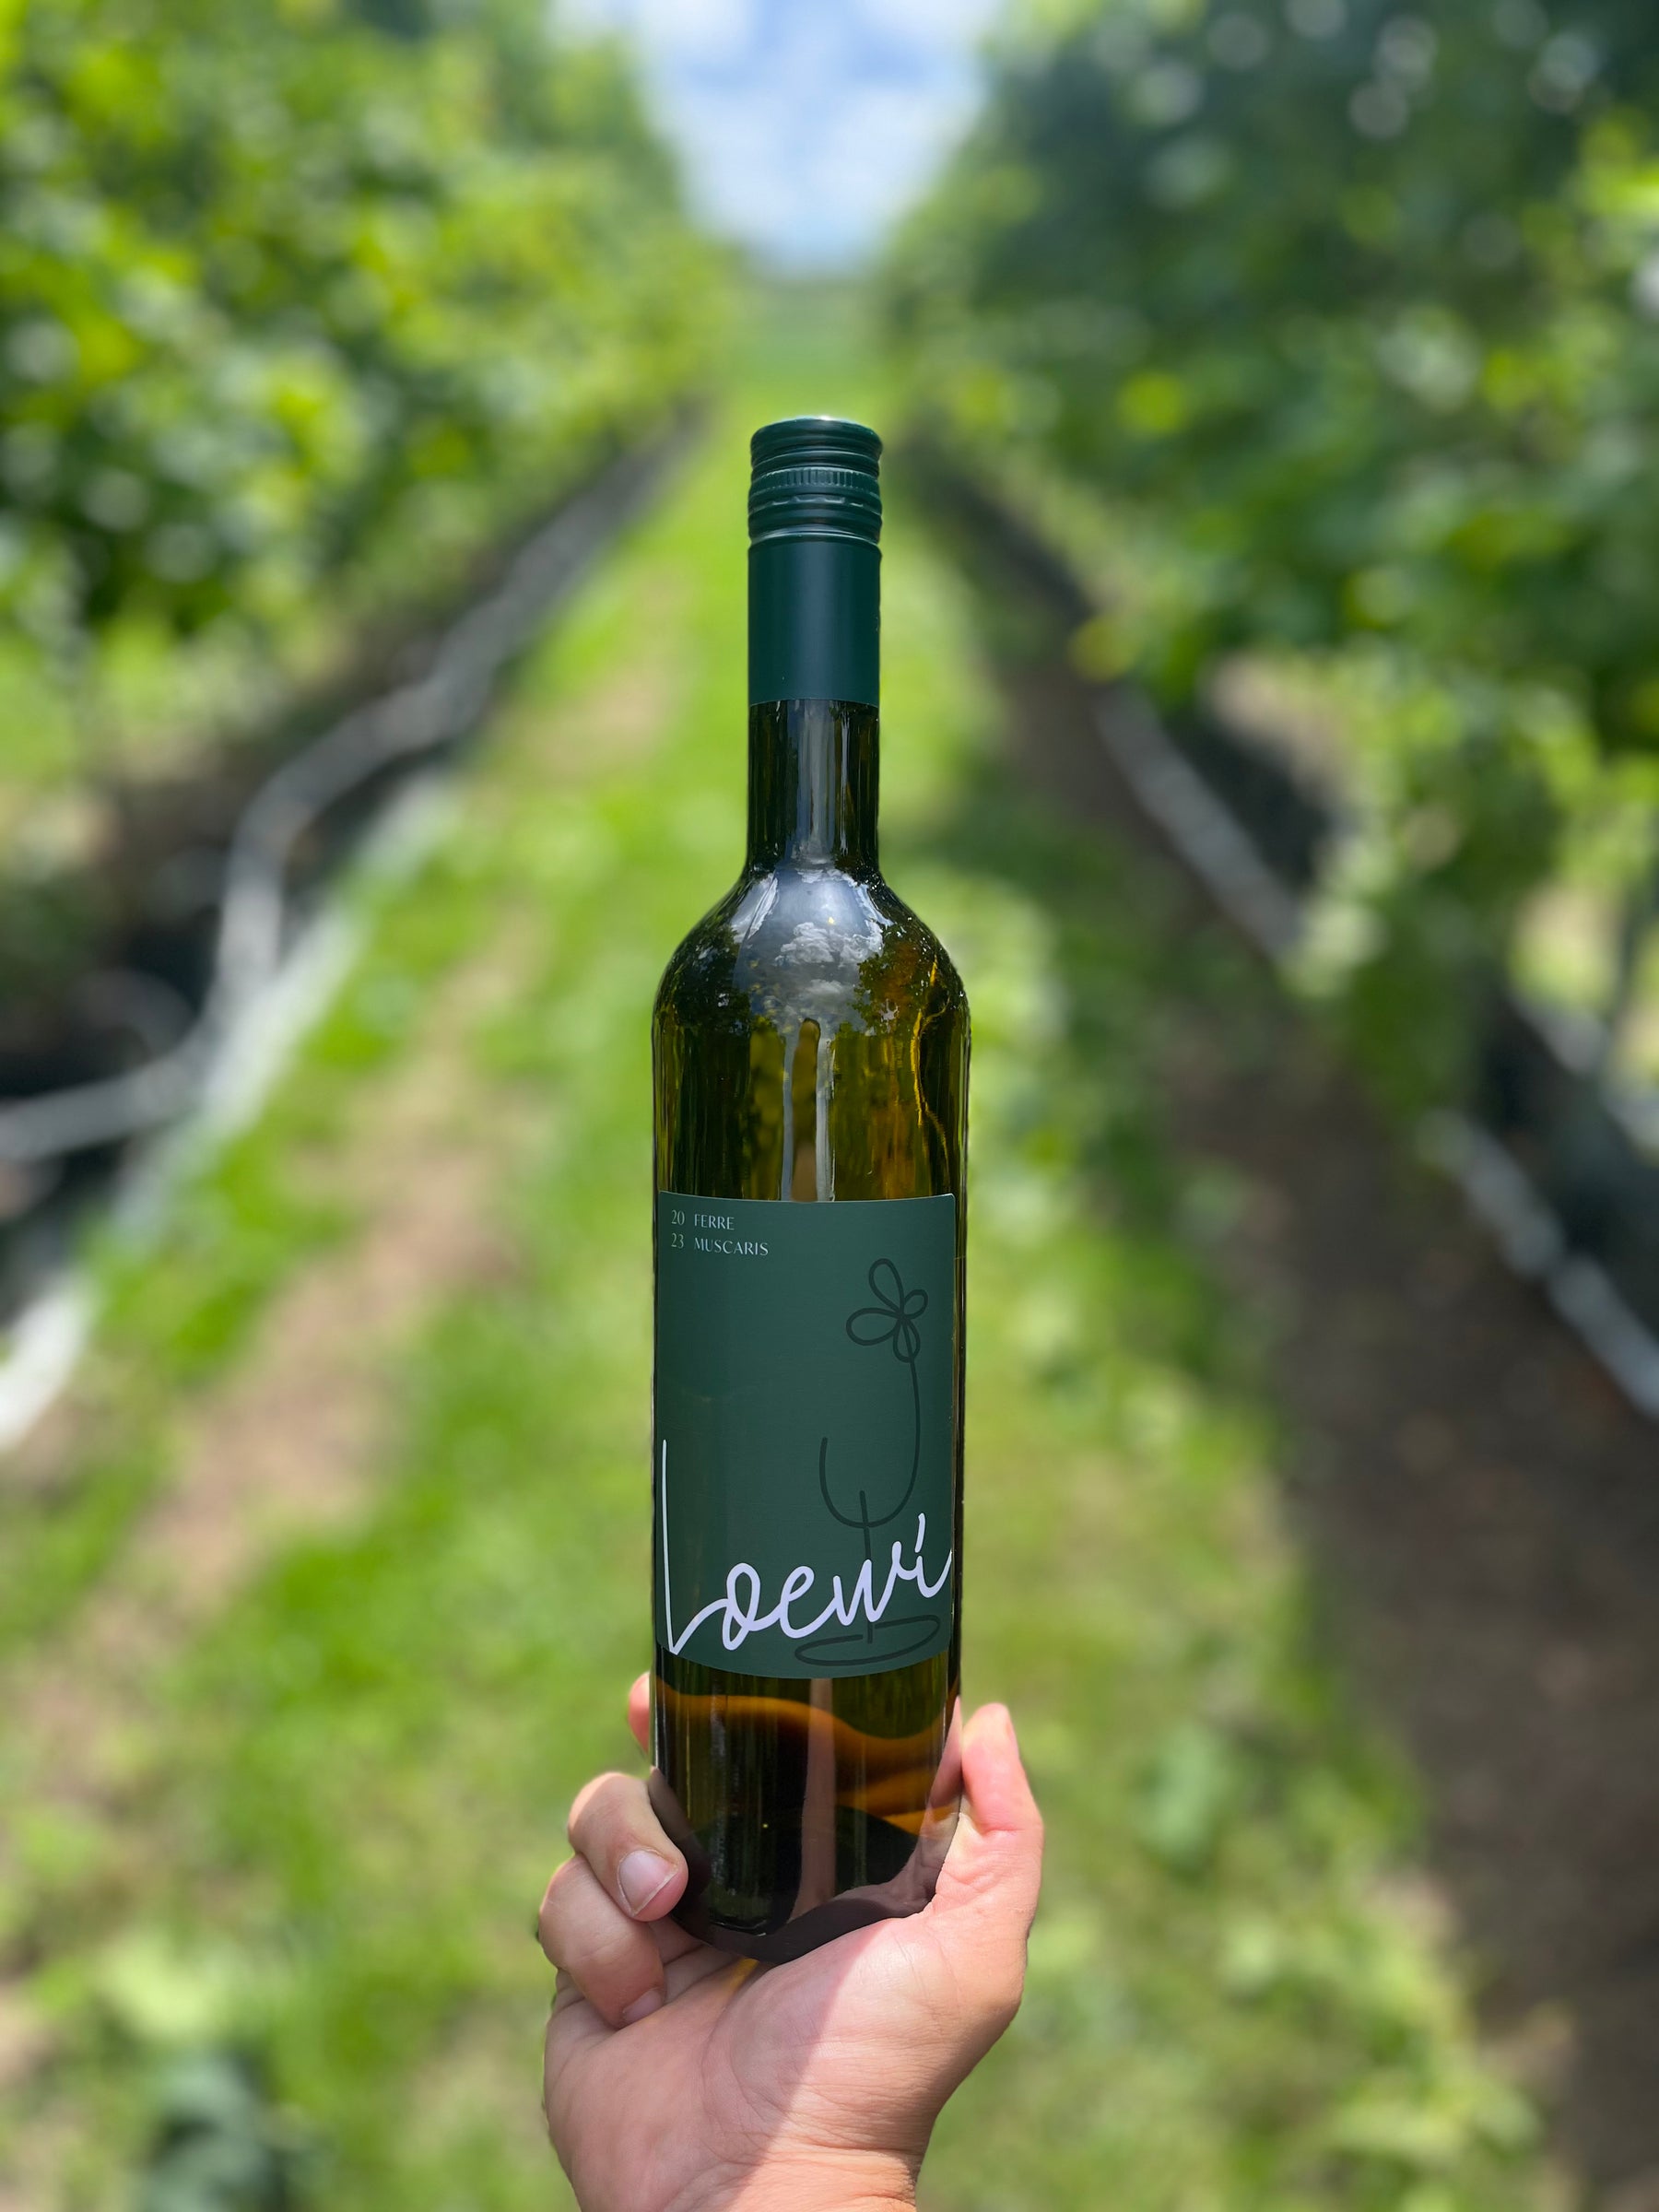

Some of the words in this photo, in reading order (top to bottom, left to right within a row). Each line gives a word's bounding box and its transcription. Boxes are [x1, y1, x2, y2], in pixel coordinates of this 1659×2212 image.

[671, 1209, 685, 1225] 20
[694, 1213, 735, 1230] FERRE
[671, 1232, 684, 1249] 23
[694, 1237, 769, 1256] MUSCARIS
